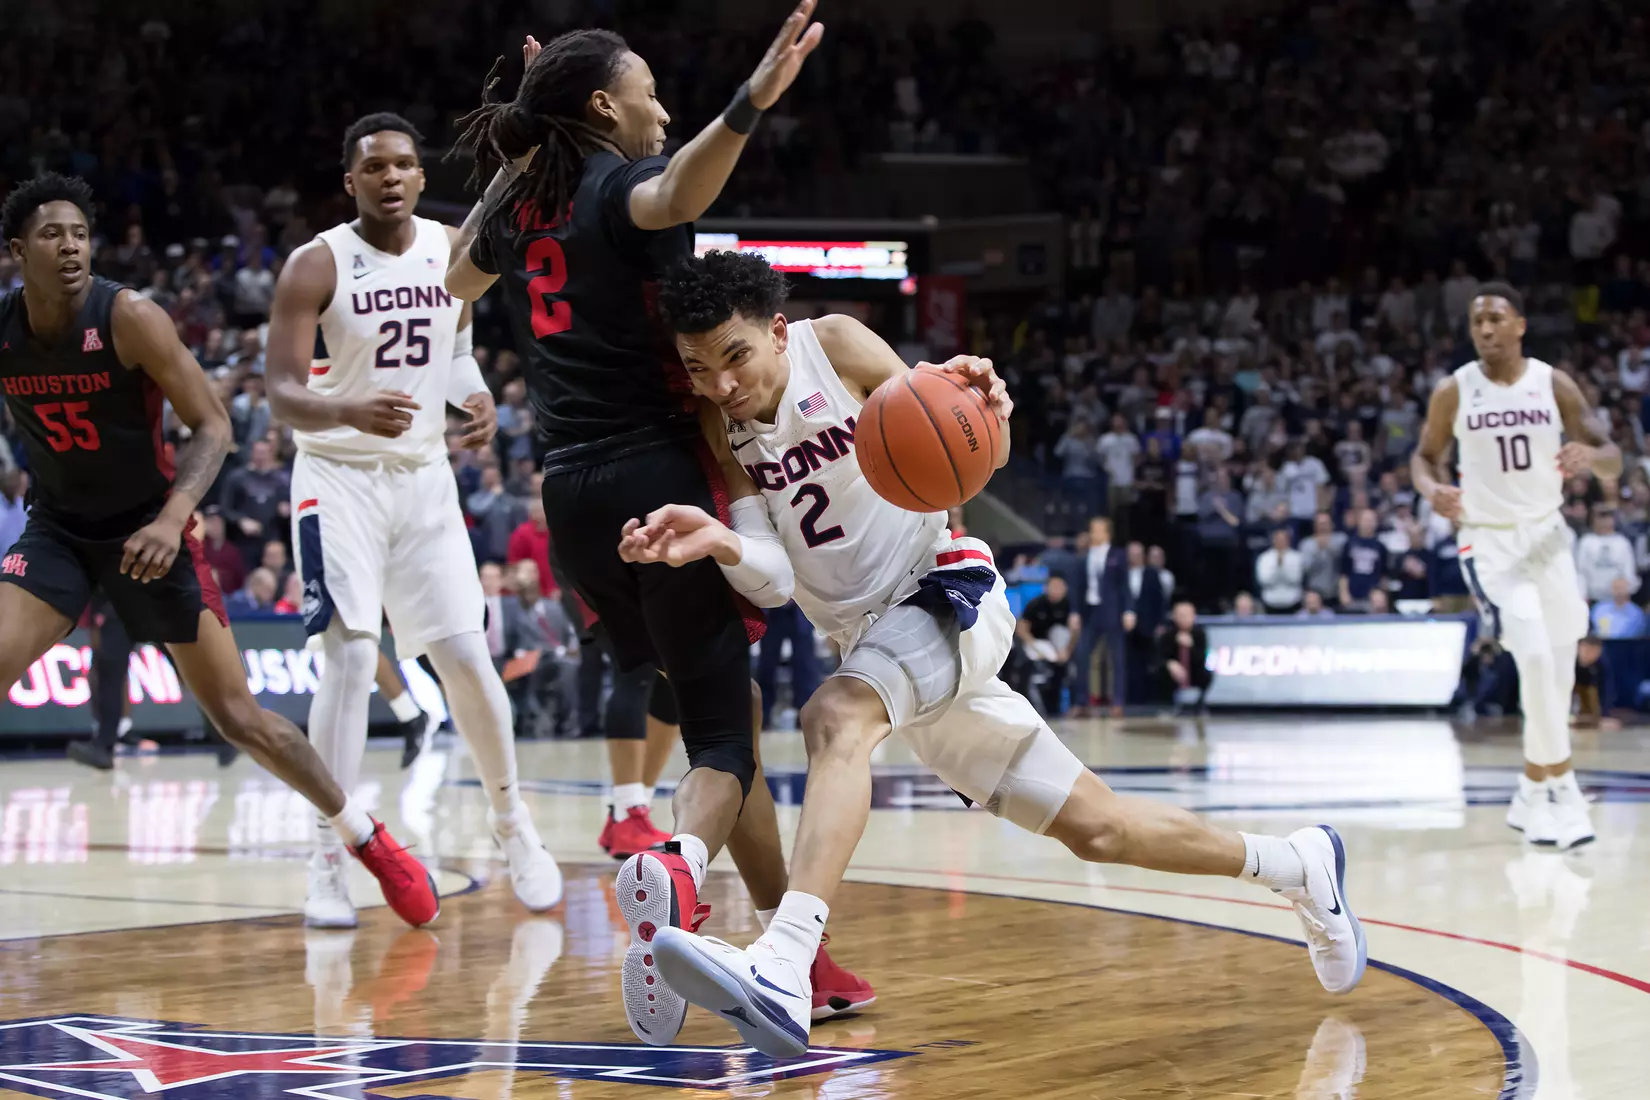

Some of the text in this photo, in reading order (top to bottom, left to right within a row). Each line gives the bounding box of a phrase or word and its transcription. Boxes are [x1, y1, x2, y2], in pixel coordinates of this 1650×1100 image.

[351, 285, 452, 316] UCONN
[525, 236, 573, 340] 2
[375, 318, 431, 368] 25
[2, 371, 112, 396] HOUSTON
[33, 401, 101, 453] 55
[951, 404, 980, 453] UCONN
[1466, 409, 1552, 431] UCONN
[1496, 434, 1532, 473] 10
[789, 482, 846, 549] 2
